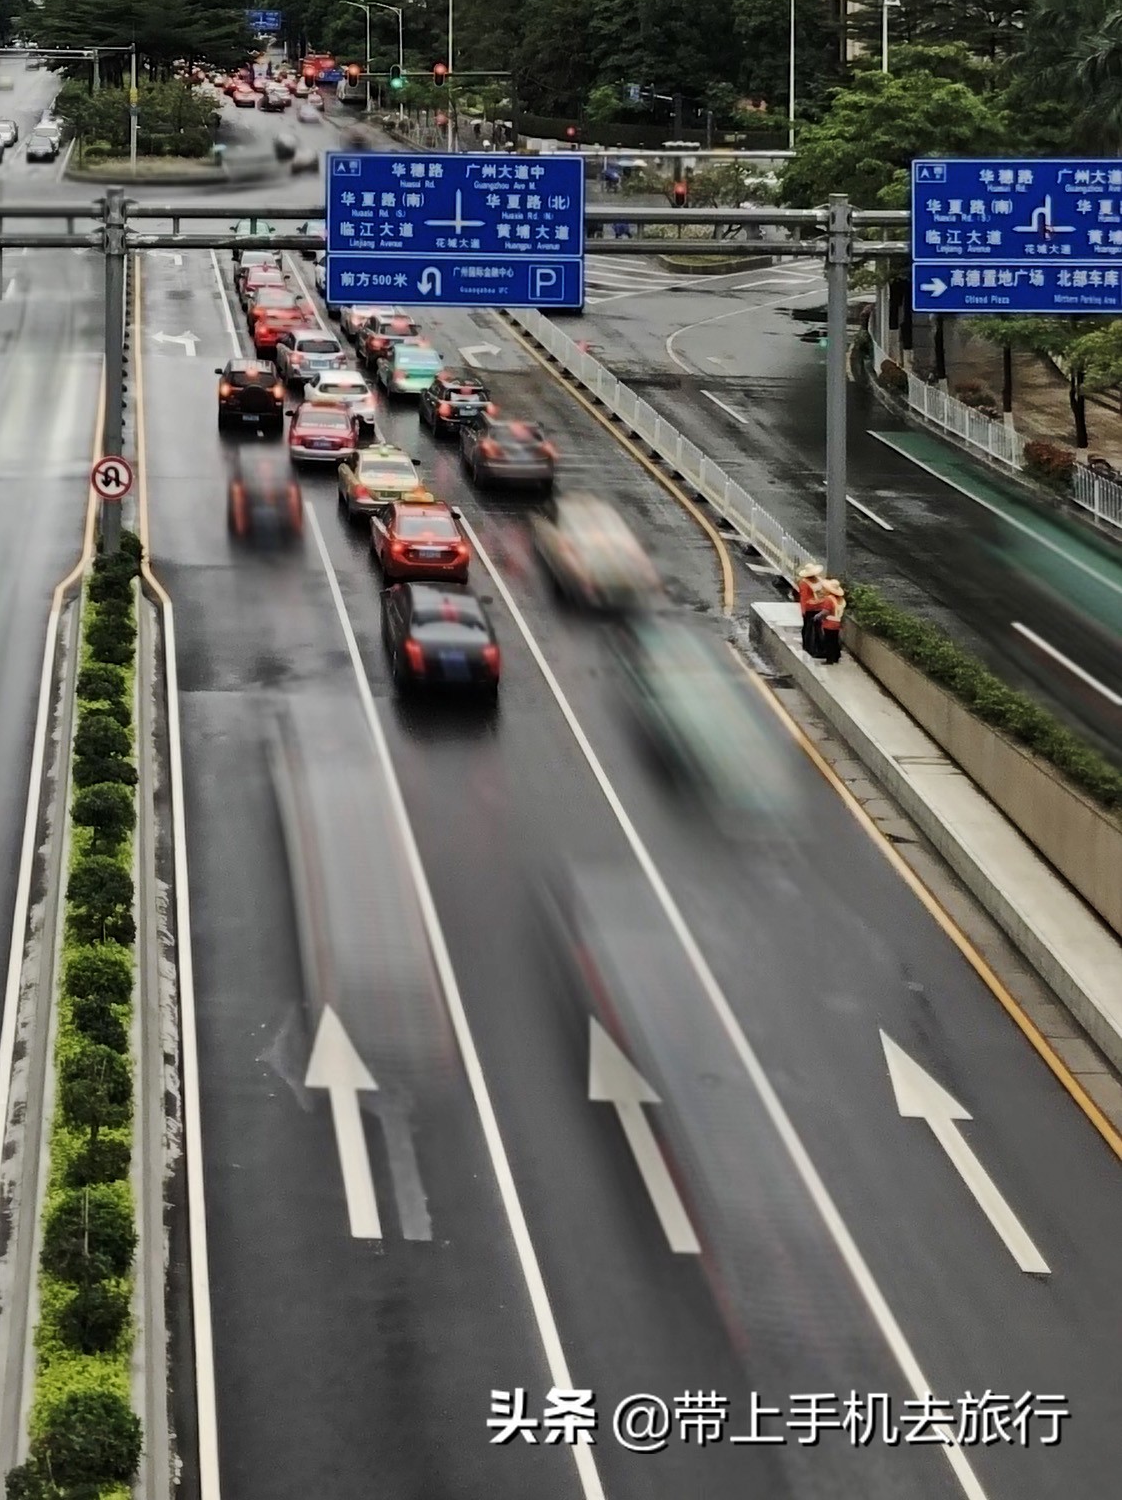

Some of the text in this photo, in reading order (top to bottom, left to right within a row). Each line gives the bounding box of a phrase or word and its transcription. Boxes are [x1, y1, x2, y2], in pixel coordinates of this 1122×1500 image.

[391, 162, 444, 178] 华穗路
[465, 163, 545, 180] 广州大道中
[473, 180, 510, 191] Guangzhou
[1076, 199, 1122, 215] 华夏
[340, 221, 414, 238] 临江大道
[496, 223, 570, 240] 黄埔大道
[925, 229, 1002, 245] 临江大道
[435, 237, 481, 249] 花城大道
[1024, 244, 1072, 255] 花城大道
[340, 271, 409, 288] 前方500米
[453, 266, 515, 278] 广州国际金融中心
[950, 268, 1119, 288] 高德置地广场 北部车库
